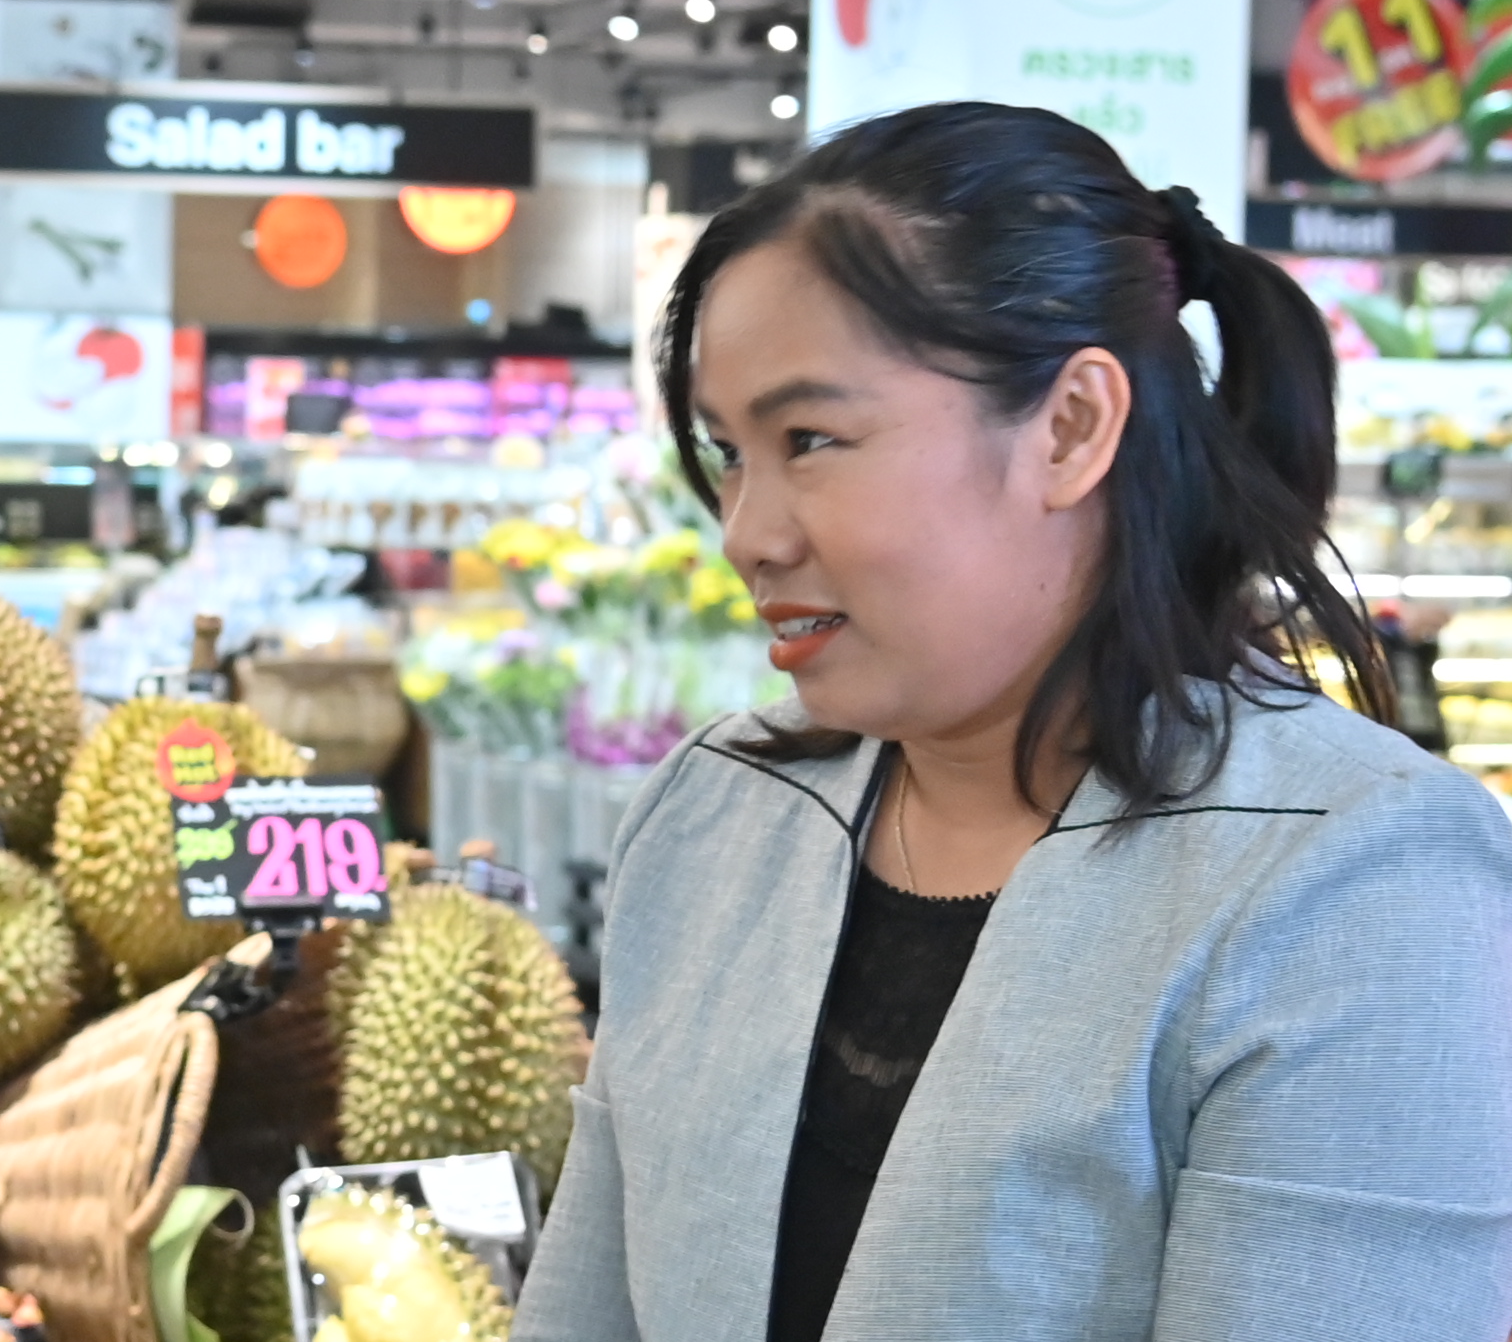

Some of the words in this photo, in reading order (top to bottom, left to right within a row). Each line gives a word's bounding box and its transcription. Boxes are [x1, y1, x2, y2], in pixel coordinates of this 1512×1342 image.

[1321, 5, 1378, 89] 1
[105, 100, 286, 173] Salad
[296, 109, 406, 177] bar
